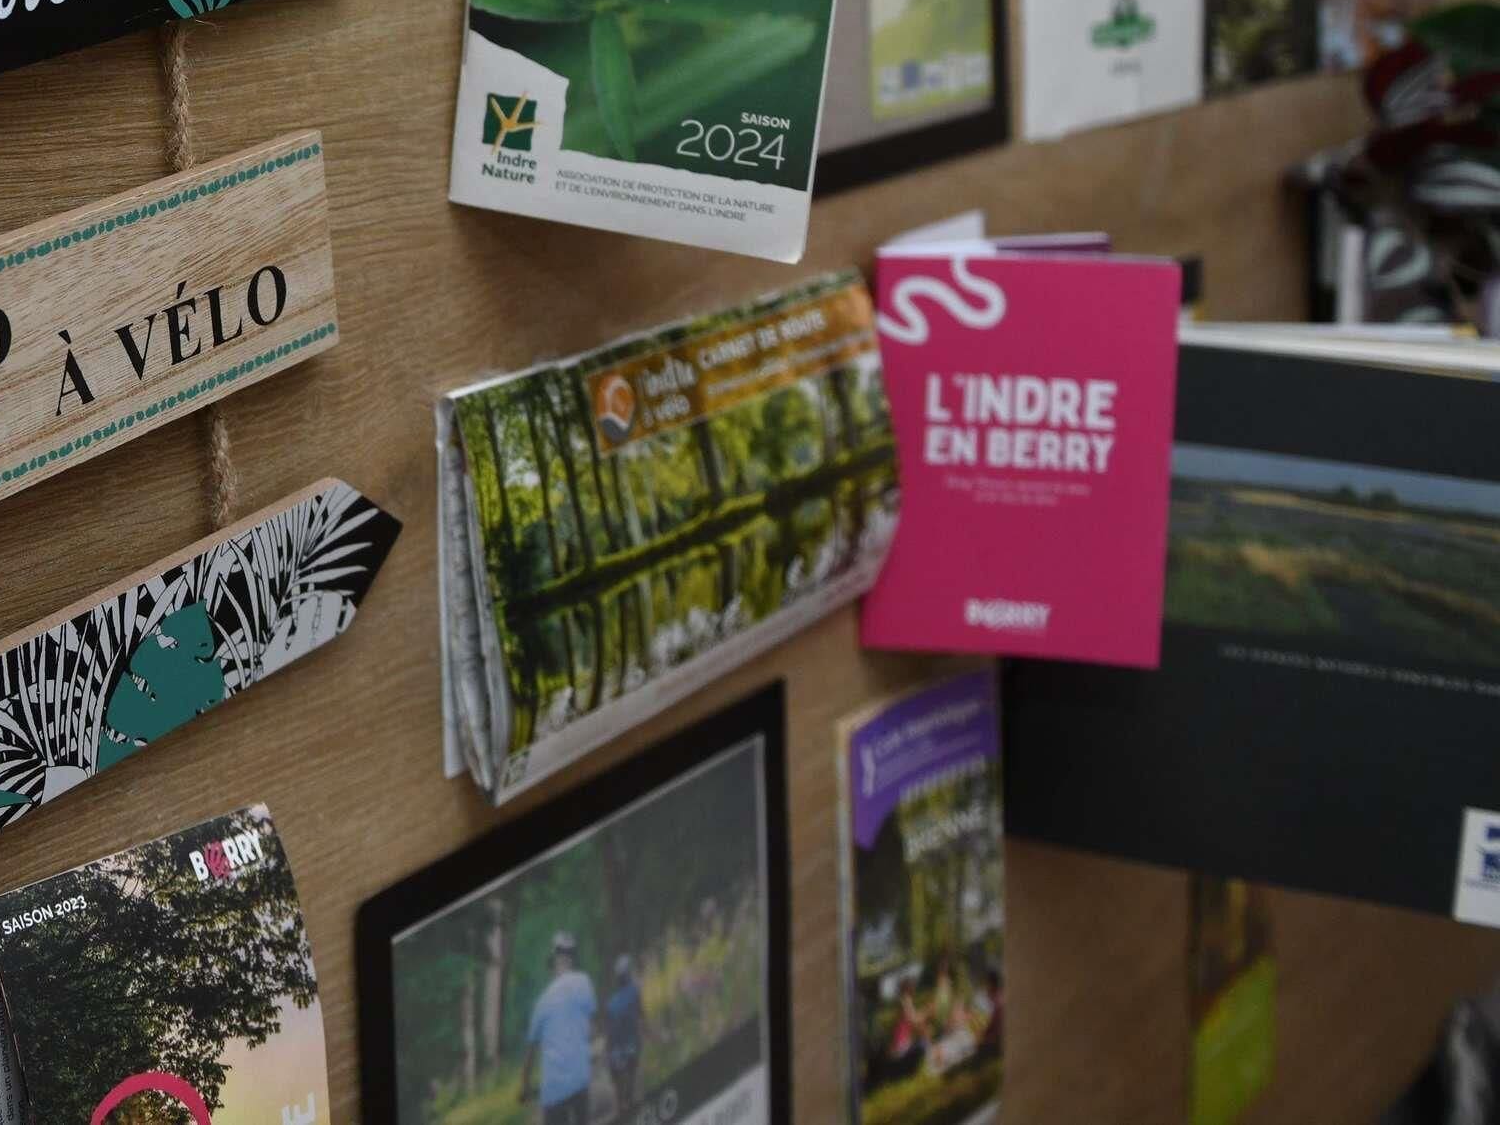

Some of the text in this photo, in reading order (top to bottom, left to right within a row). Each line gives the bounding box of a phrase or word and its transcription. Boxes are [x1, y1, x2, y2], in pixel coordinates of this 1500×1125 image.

[740, 112, 791, 130] SAISON
[497, 150, 537, 170] Indre
[676, 119, 786, 170] 2024
[482, 163, 535, 184] Nature
[55, 264, 289, 416] À VÉLO
[925, 373, 1118, 430] L'INDRE
[925, 425, 1115, 474] EN BERRY
[2, 895, 87, 935] SAISON 2023
